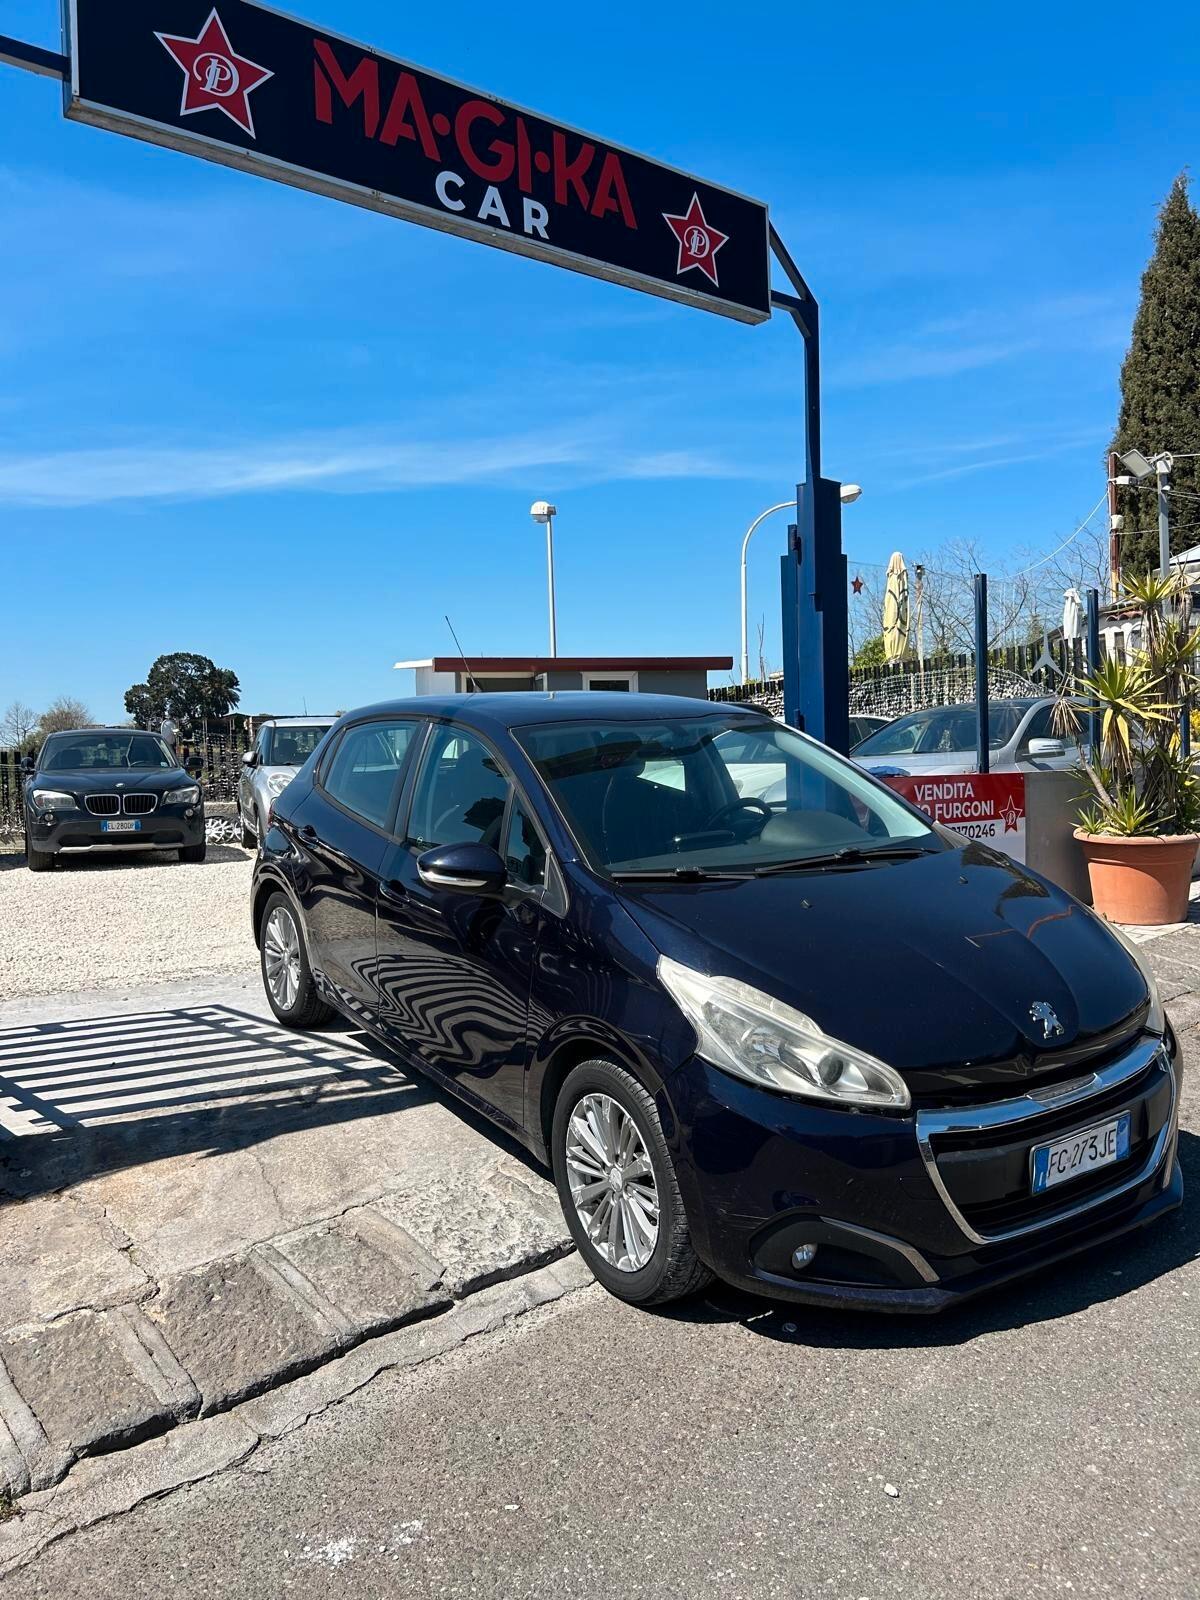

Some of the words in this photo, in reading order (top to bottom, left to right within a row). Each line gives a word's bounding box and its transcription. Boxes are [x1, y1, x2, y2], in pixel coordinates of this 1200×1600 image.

[435, 170, 550, 239] CAR
[914, 782, 975, 801] VENDITA
[935, 800, 994, 820] FURGONI
